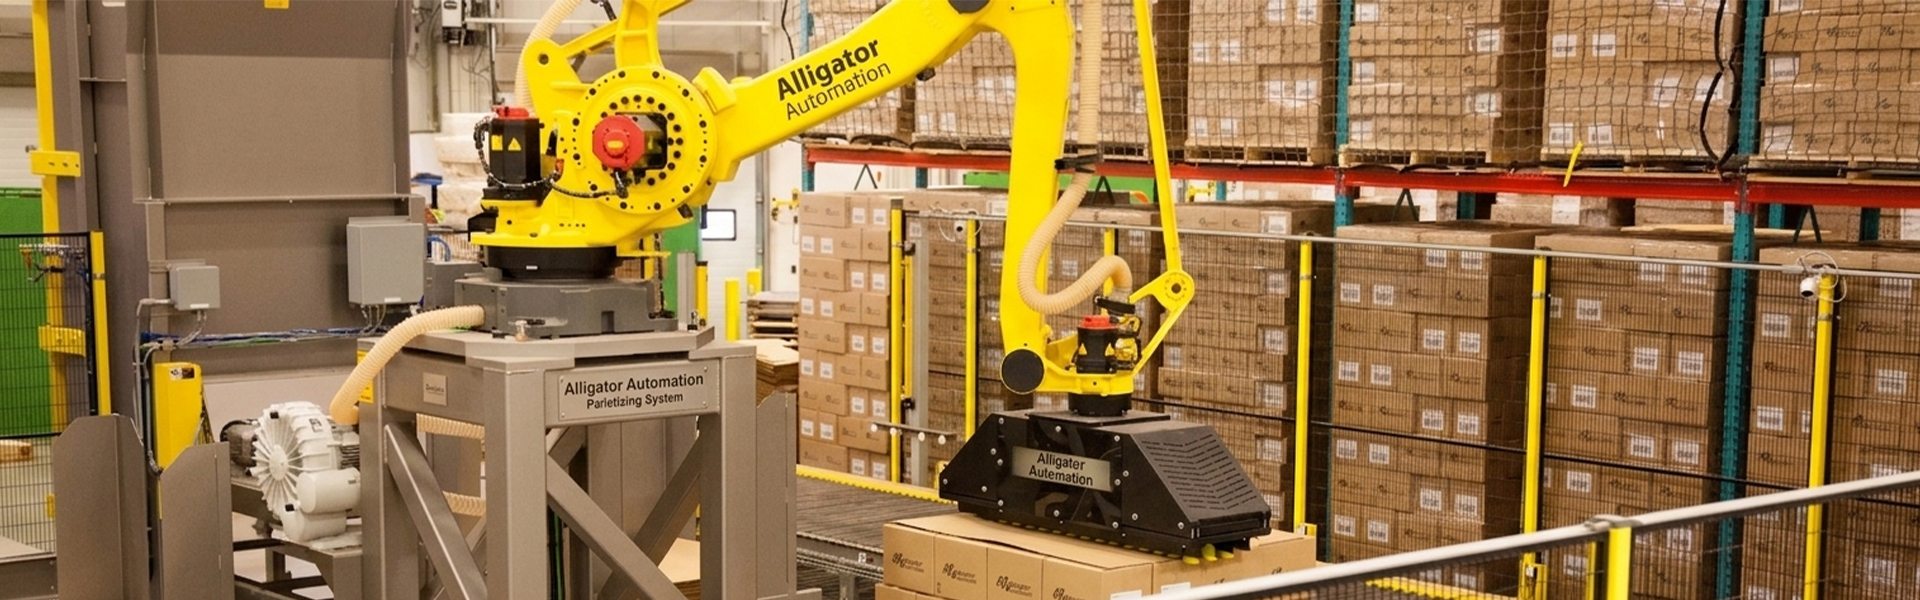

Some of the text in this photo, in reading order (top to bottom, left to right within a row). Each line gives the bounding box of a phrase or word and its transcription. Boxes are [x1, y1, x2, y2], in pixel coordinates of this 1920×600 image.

[777, 40, 878, 101] Alligator
[564, 374, 704, 396] Alligator Automation
[645, 393, 683, 406] System
